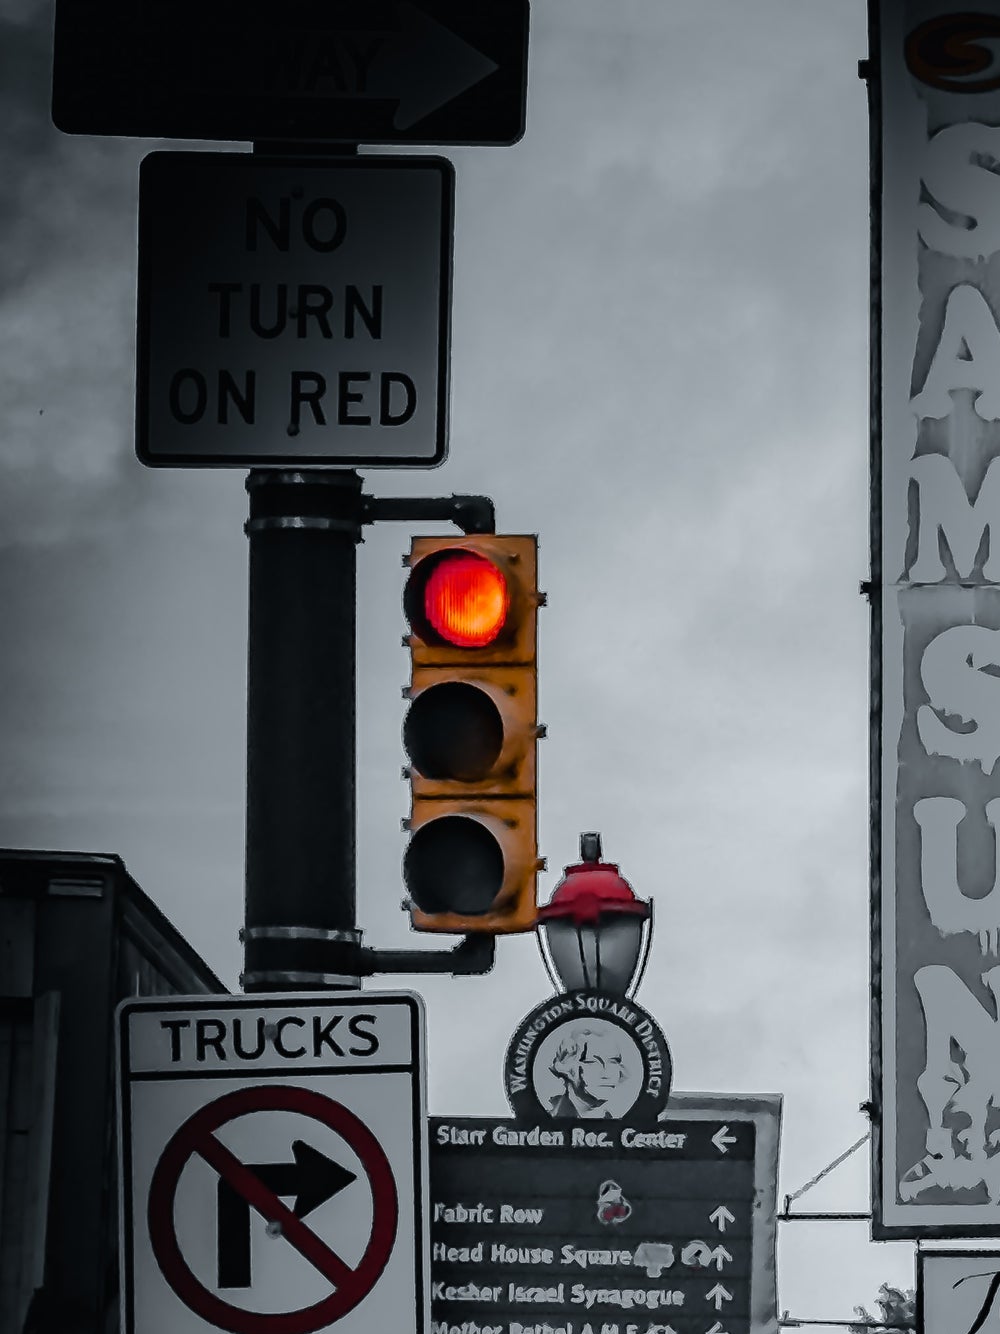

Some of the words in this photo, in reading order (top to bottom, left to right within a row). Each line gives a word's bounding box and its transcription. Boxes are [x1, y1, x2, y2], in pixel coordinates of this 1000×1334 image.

[246, 197, 347, 253] NO
[208, 284, 383, 340] TURN
[169, 368, 256, 425] ON
[291, 371, 417, 427] RED
[161, 1015, 379, 1061] TRUCKS
[509, 1000, 573, 1094] WASHINGTON
[575, 993, 638, 1026] SQUARE
[634, 1018, 663, 1098] DISTRICT
[436, 1125, 486, 1146] Starr
[492, 1126, 564, 1148] Garden
[571, 1128, 614, 1148] Rec.
[620, 1128, 687, 1149] Center
[433, 1202, 494, 1224] Fabric
[500, 1204, 544, 1225] Row
[432, 1243, 483, 1264] Head
[490, 1243, 554, 1265] House
[560, 1245, 632, 1269] Square
[431, 1283, 502, 1303] Kesher
[508, 1283, 564, 1304] Israel
[570, 1284, 685, 1310] Synagogue
